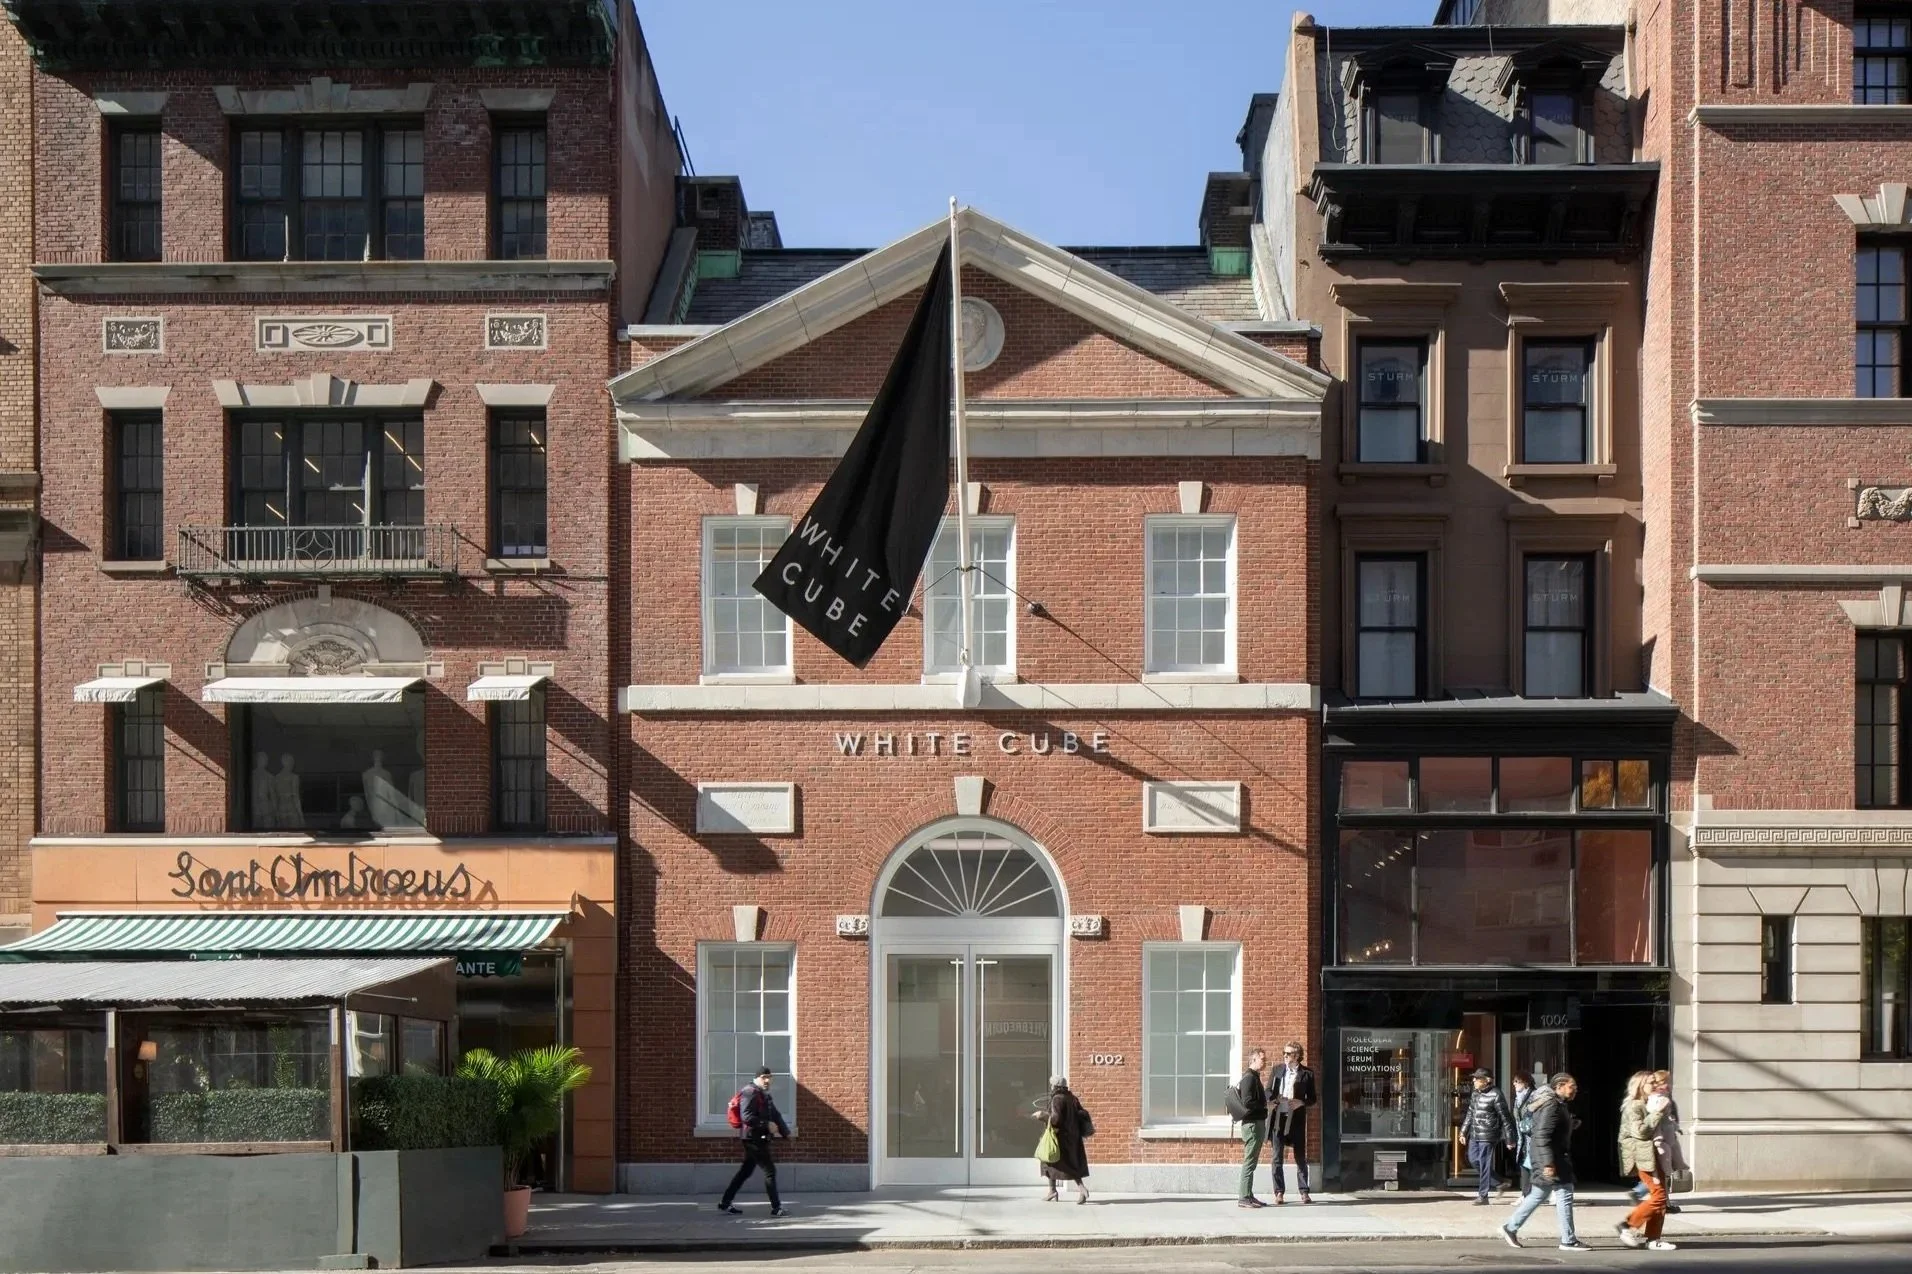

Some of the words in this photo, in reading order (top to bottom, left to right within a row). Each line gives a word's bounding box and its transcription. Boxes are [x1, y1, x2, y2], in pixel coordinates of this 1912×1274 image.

[1368, 372, 1413, 382] STURM
[1532, 374, 1578, 383] STURM
[800, 515, 900, 612] WHITE
[782, 562, 868, 638] CUBE
[835, 732, 970, 754] WHITE
[998, 732, 1109, 754] CUBE
[168, 851, 261, 897] Sant
[1540, 1013, 1569, 1026] 1006
[1088, 1054, 1123, 1065] 1002
[1346, 1055, 1372, 1063] SERUM
